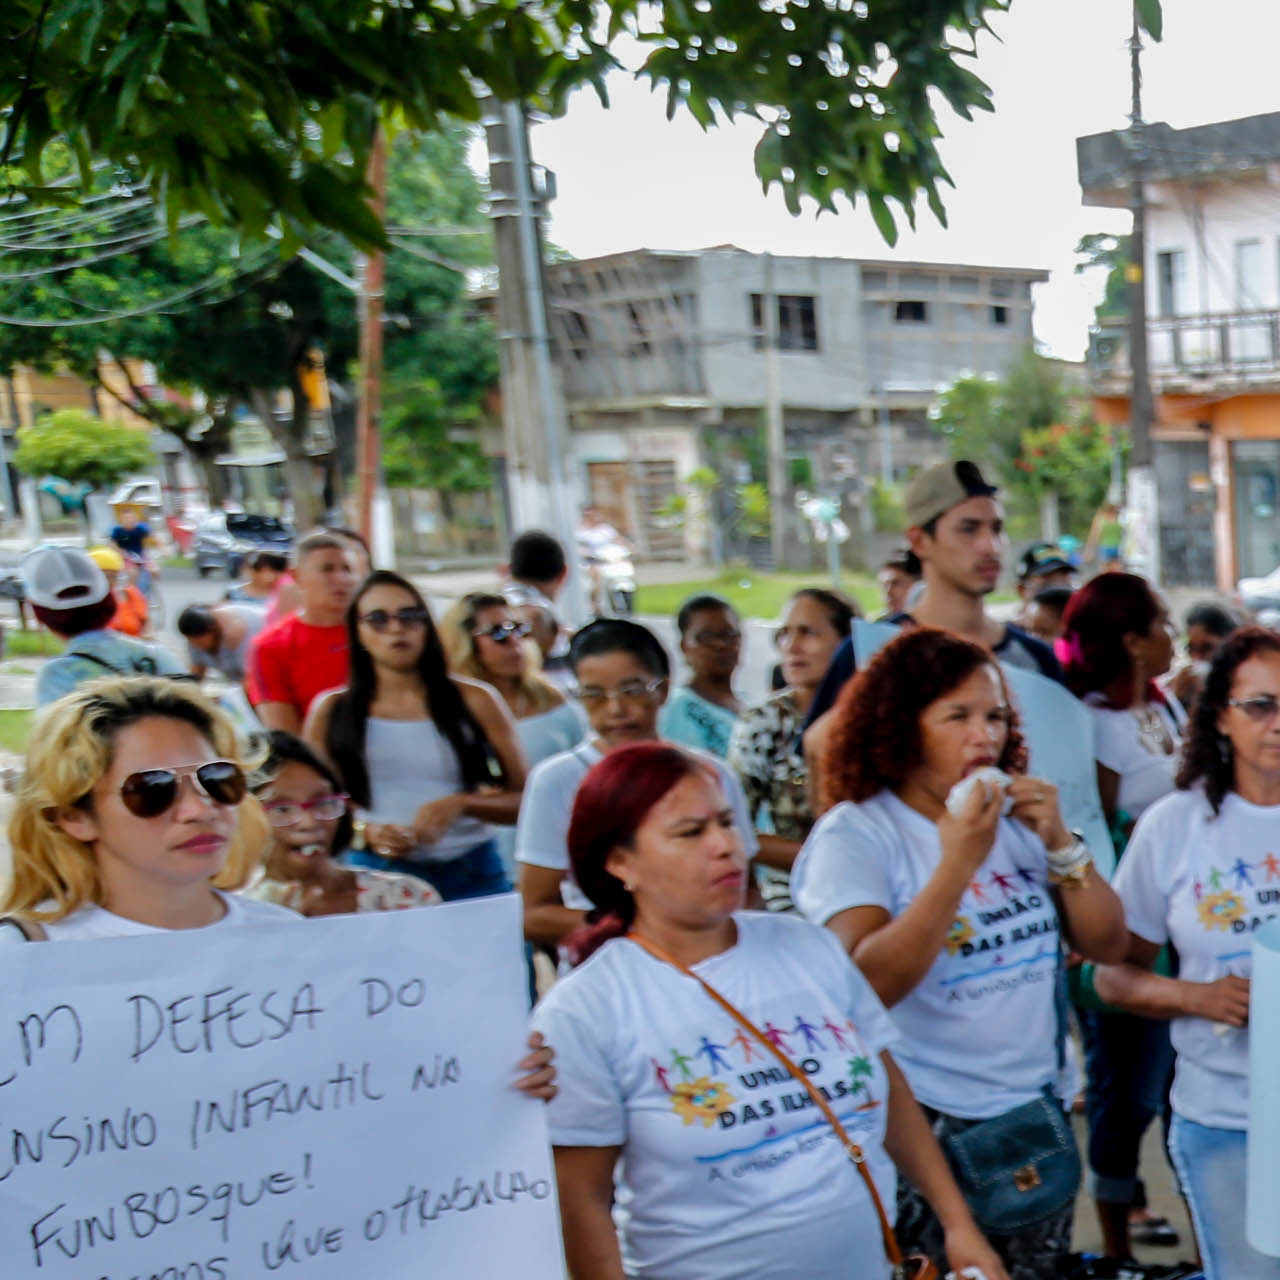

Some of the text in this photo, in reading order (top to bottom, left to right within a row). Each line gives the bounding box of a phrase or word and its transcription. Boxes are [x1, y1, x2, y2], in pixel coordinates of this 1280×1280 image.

[1232, 915, 1276, 934] DA
[961, 934, 1005, 958] DAS
[0, 978, 426, 1086] M DEFESA DO
[410, 1054, 461, 1093] NA
[738, 1058, 821, 1089] UNIO
[718, 1099, 776, 1130] DAS
